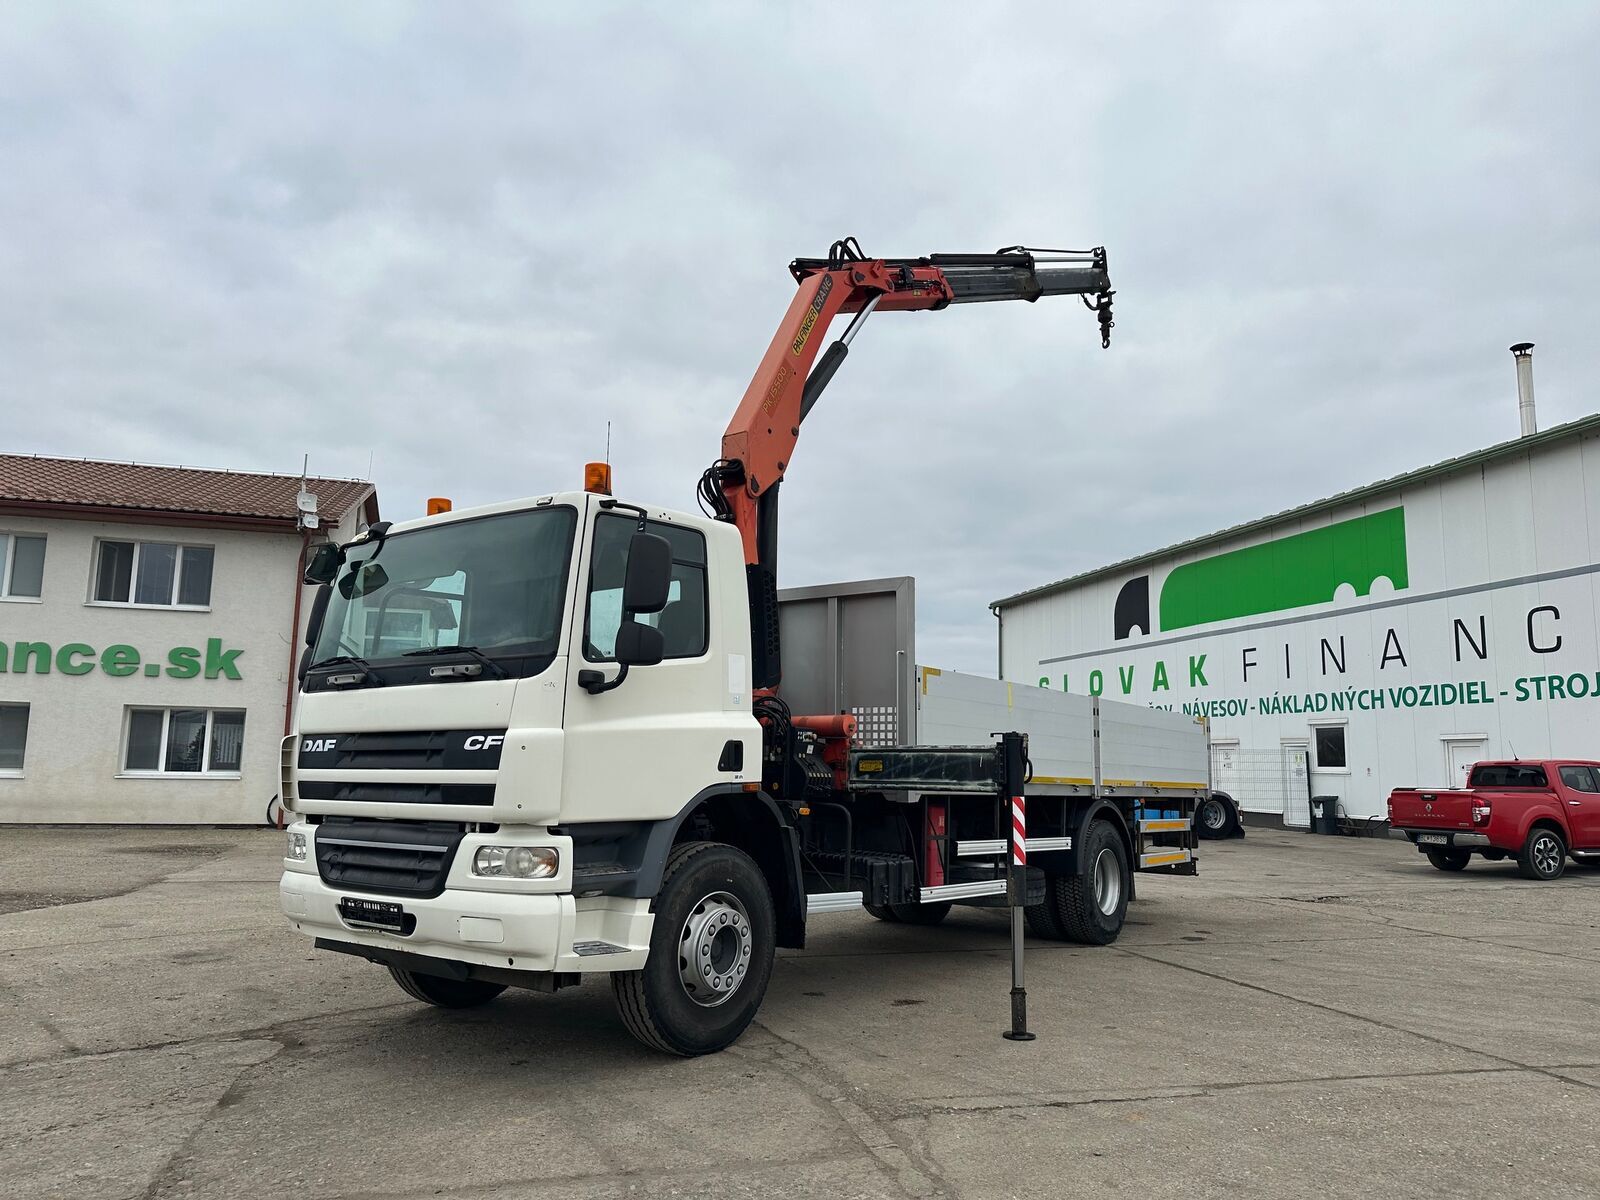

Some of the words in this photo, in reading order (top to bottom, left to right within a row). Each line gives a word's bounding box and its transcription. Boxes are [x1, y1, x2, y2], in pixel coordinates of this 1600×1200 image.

[793, 308, 817, 353] PALFINGER
[814, 276, 832, 310] CRANE
[0, 637, 245, 680] nce.sk
[1243, 605, 1562, 683] FINANC
[1183, 697, 1248, 718] NÁVESOV
[1388, 680, 1494, 708] VOZIDIEL
[1515, 671, 1600, 702] STROJ
[301, 739, 337, 752] DAF
[463, 735, 505, 750] CF
